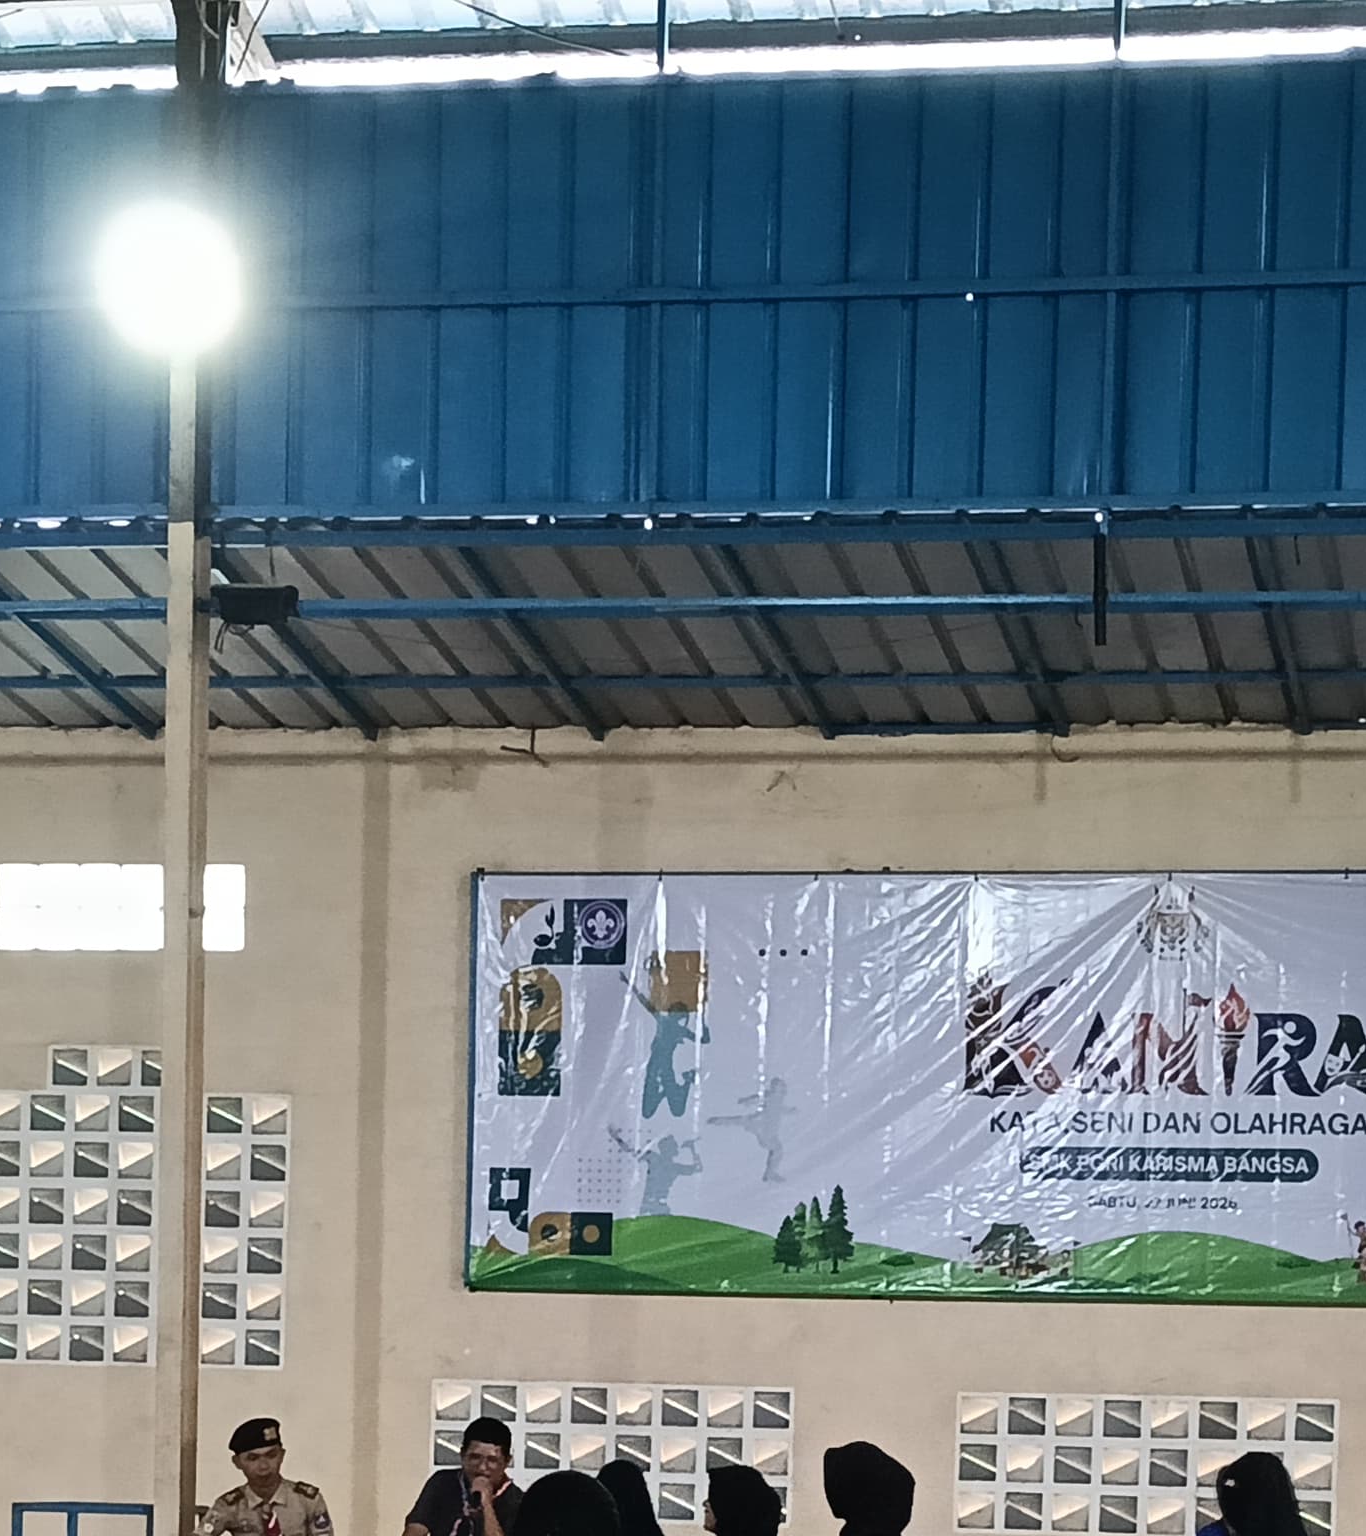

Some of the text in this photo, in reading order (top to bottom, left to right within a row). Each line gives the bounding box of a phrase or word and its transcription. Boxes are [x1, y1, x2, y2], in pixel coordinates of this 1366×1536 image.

[1143, 1112, 1201, 1134] DAN
[1129, 1155, 1219, 1173] KARISMA
[1224, 1156, 1309, 1174] BANGSA
